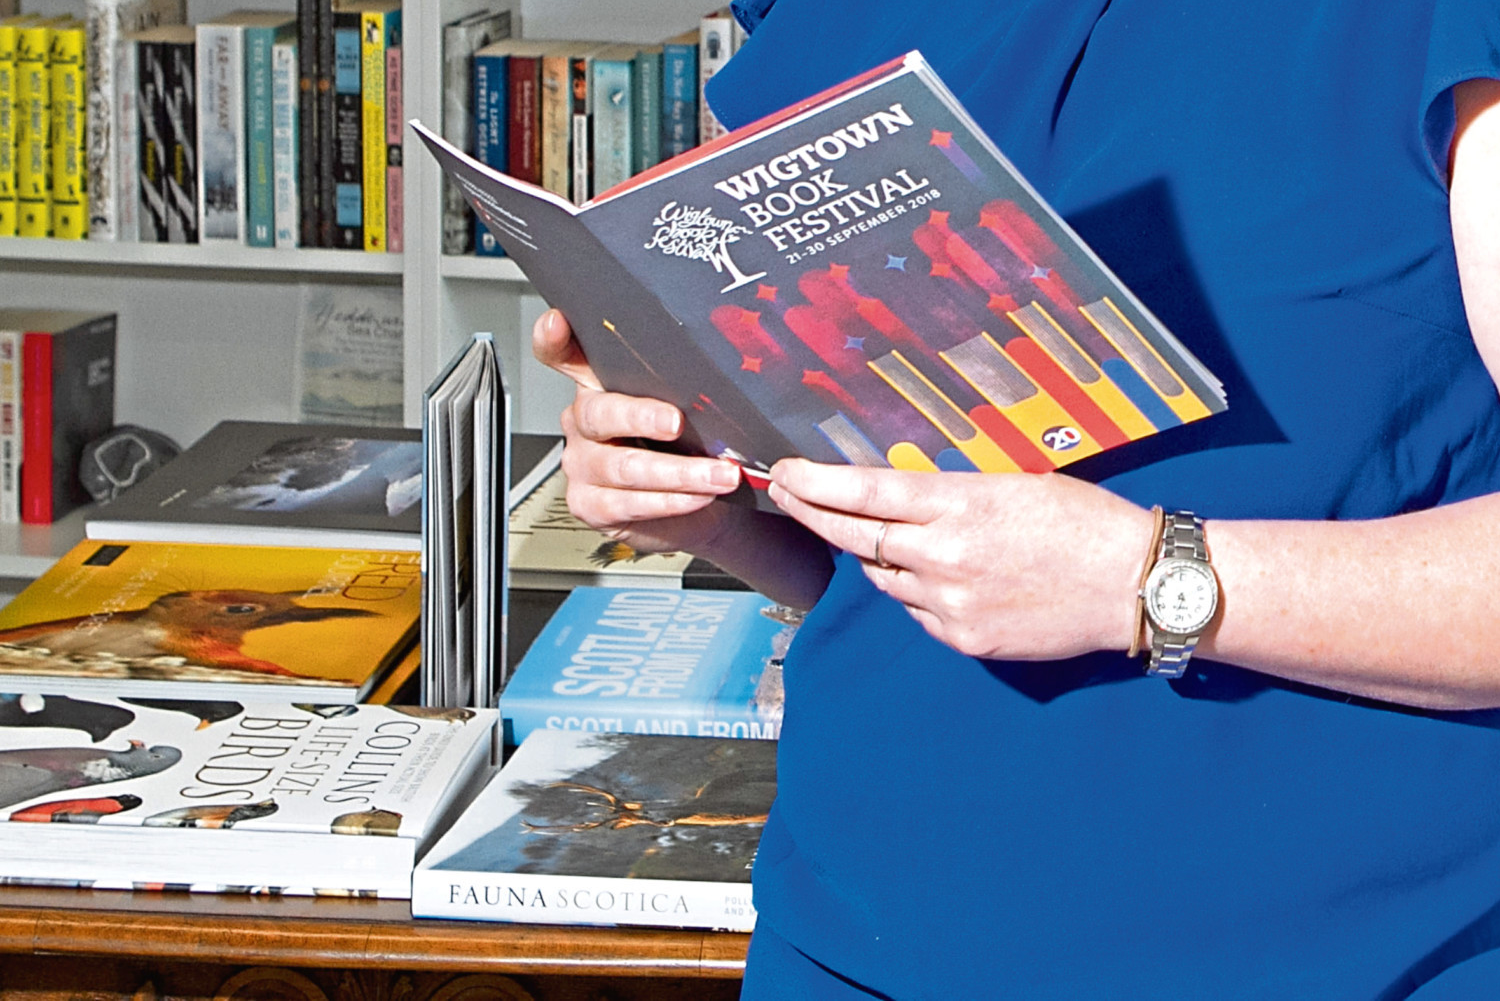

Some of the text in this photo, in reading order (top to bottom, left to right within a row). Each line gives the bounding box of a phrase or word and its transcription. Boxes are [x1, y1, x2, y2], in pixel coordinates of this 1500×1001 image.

[478, 65, 488, 119] BETWEEN
[672, 100, 683, 120] Say
[673, 76, 683, 98] Not
[714, 102, 915, 202] WIGTOWN
[660, 201, 733, 230] Wigtown
[739, 168, 849, 228] BOOK
[762, 169, 930, 253] FESTIVAL
[827, 204, 908, 247] SEPTEMBER
[908, 188, 942, 213] 2018
[1044, 427, 1082, 451] 20
[553, 591, 681, 697] SCOTLAND
[627, 593, 737, 699] FROM THE SKY
[179, 716, 313, 800] BIRDS
[268, 725, 359, 796] LIFE-SIZE
[323, 721, 421, 804] COLLINS
[448, 884, 691, 914] FAUNA SCOTICA
